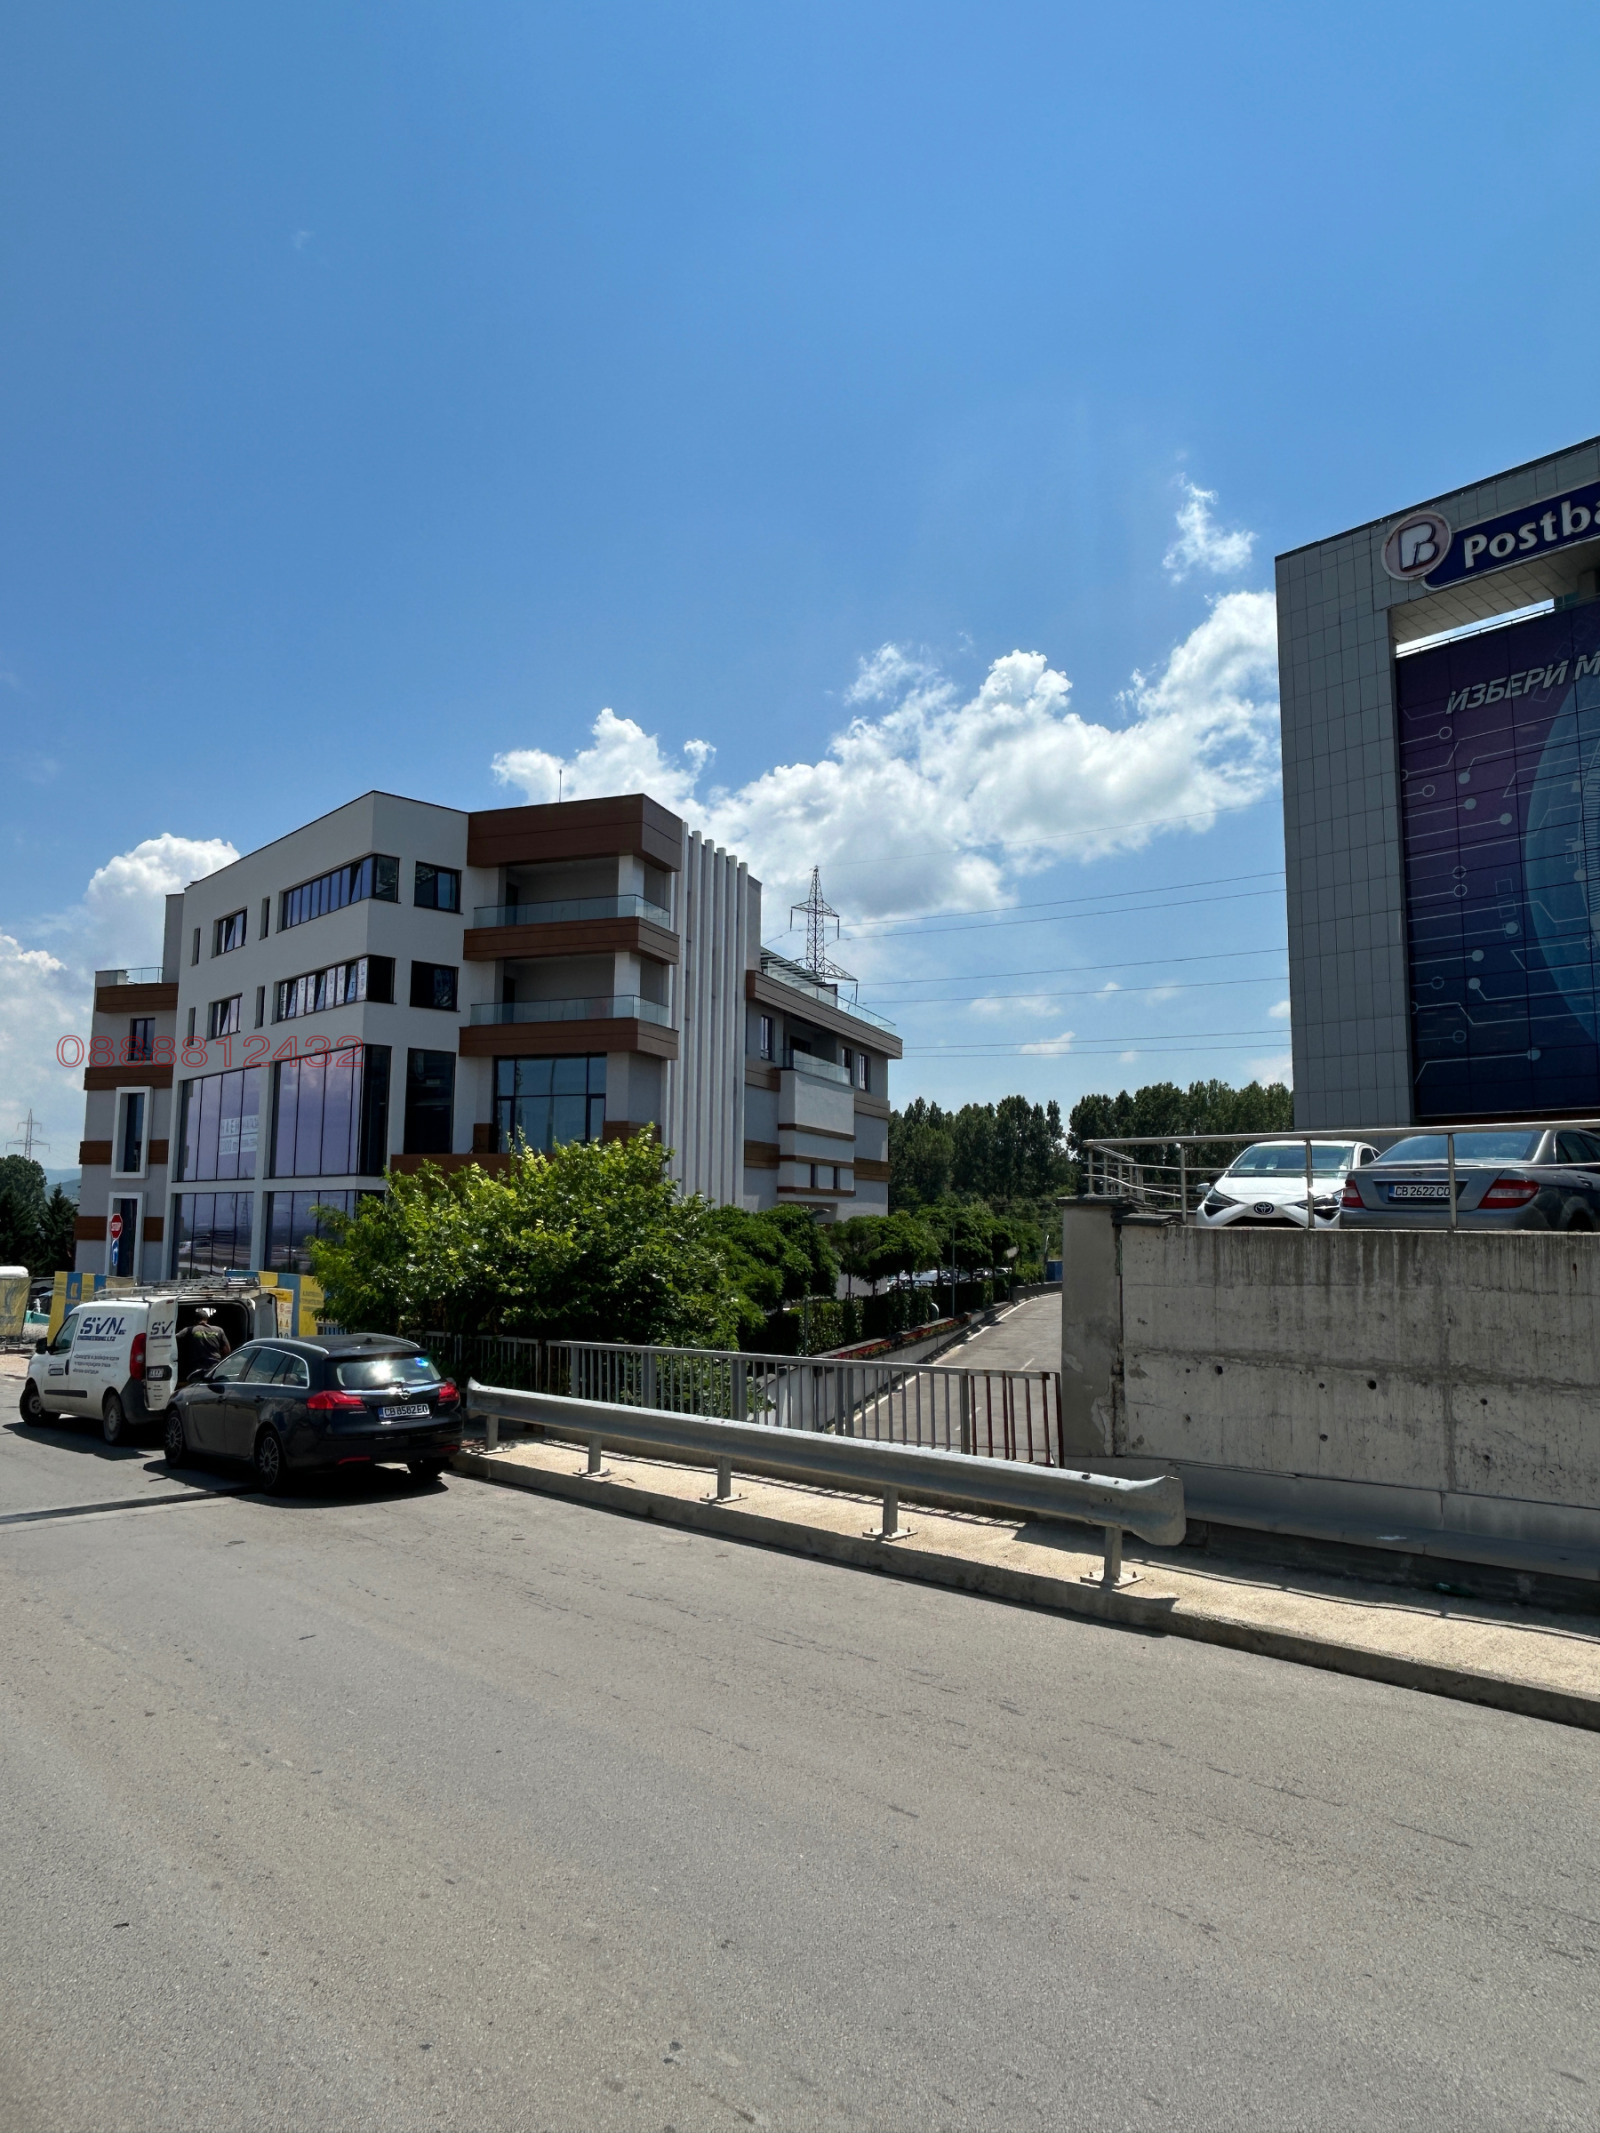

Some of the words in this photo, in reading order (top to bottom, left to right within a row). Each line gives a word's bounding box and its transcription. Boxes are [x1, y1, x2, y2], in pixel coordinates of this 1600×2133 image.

[1463, 500, 1600, 569] Postb
[1445, 659, 1570, 715] ИЗБЕРИ
[1395, 1186, 1408, 1197] CB
[1410, 1186, 1435, 1197] 2622
[150, 1320, 174, 1336] SV
